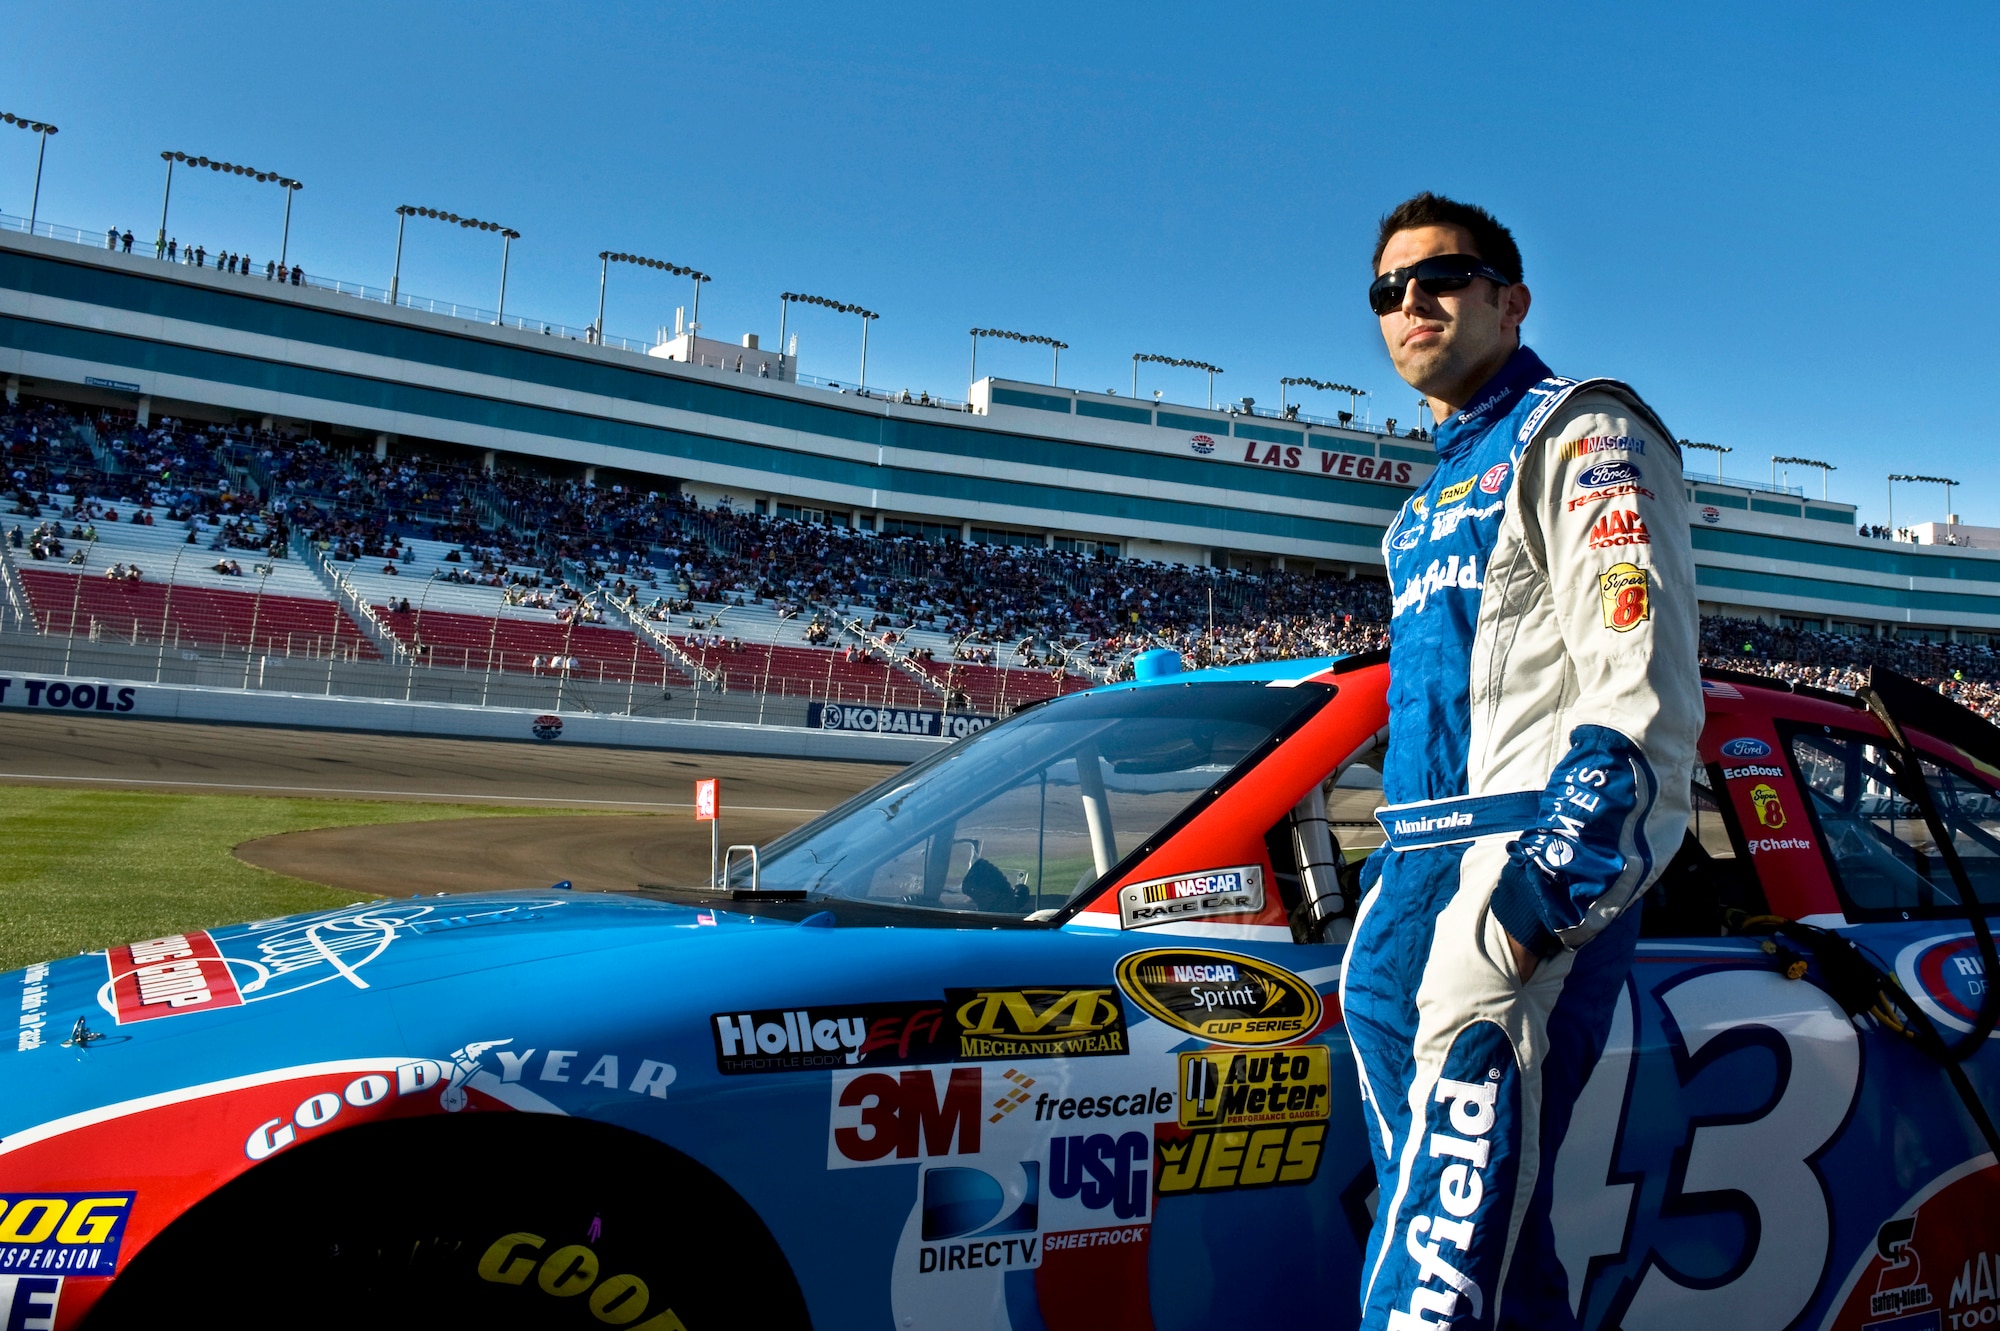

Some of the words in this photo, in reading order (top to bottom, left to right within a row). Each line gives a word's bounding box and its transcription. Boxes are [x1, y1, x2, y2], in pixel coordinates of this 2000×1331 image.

[1458, 387, 1511, 424] Smithfield
[1587, 435, 1645, 456] NASCAR
[1244, 441, 1302, 469] LAS
[1321, 451, 1413, 484] VEGAS
[1590, 463, 1632, 485] Ford
[1589, 534, 1651, 550] TOOLS
[1603, 574, 1646, 598] Super
[1611, 587, 1646, 627] 8
[25, 680, 136, 712] TOOLS
[844, 708, 933, 735] KOBALT
[941, 714, 992, 739] TOO
[1733, 740, 1764, 756] Ford
[1723, 765, 1783, 780] EcoBoost
[1753, 790, 1777, 805] Super
[1394, 811, 1473, 835] Almirola
[1765, 800, 1784, 827] 8
[1760, 838, 1810, 852] Charter
[1174, 873, 1238, 898] NASCAR
[1132, 902, 1198, 920] RACE
[1202, 895, 1250, 910] CAR
[1173, 965, 1237, 983] NASCAR
[1191, 985, 1257, 1012] Sprint
[717, 1010, 868, 1065] Holley
[1207, 1021, 1243, 1035] CUP
[1245, 1020, 1301, 1032] SERIES
[960, 1036, 1065, 1057] MECHANIX
[1066, 1031, 1123, 1053] WEAR
[724, 1056, 800, 1071] THROTTLE
[803, 1055, 843, 1067] BODY
[1224, 1052, 1310, 1085] Auto
[245, 1060, 441, 1161] GOOD
[495, 1048, 677, 1100] YEAR
[1035, 1086, 1173, 1122] freescale
[1220, 1083, 1327, 1117] Meter
[834, 1067, 982, 1162] 3M
[1227, 1113, 1286, 1124] PERFORMANCE
[1289, 1110, 1320, 1120] GAUGES
[1158, 1124, 1326, 1192] JEGS
[1048, 1131, 1149, 1219] USG
[1044, 1228, 1144, 1251] SHEETROCK
[0, 1247, 101, 1269] SPENSION
[919, 1238, 1037, 1274] DIRECTV
[1948, 1251, 2000, 1310] MA
[1872, 1286, 1927, 1314] safety-kleen
